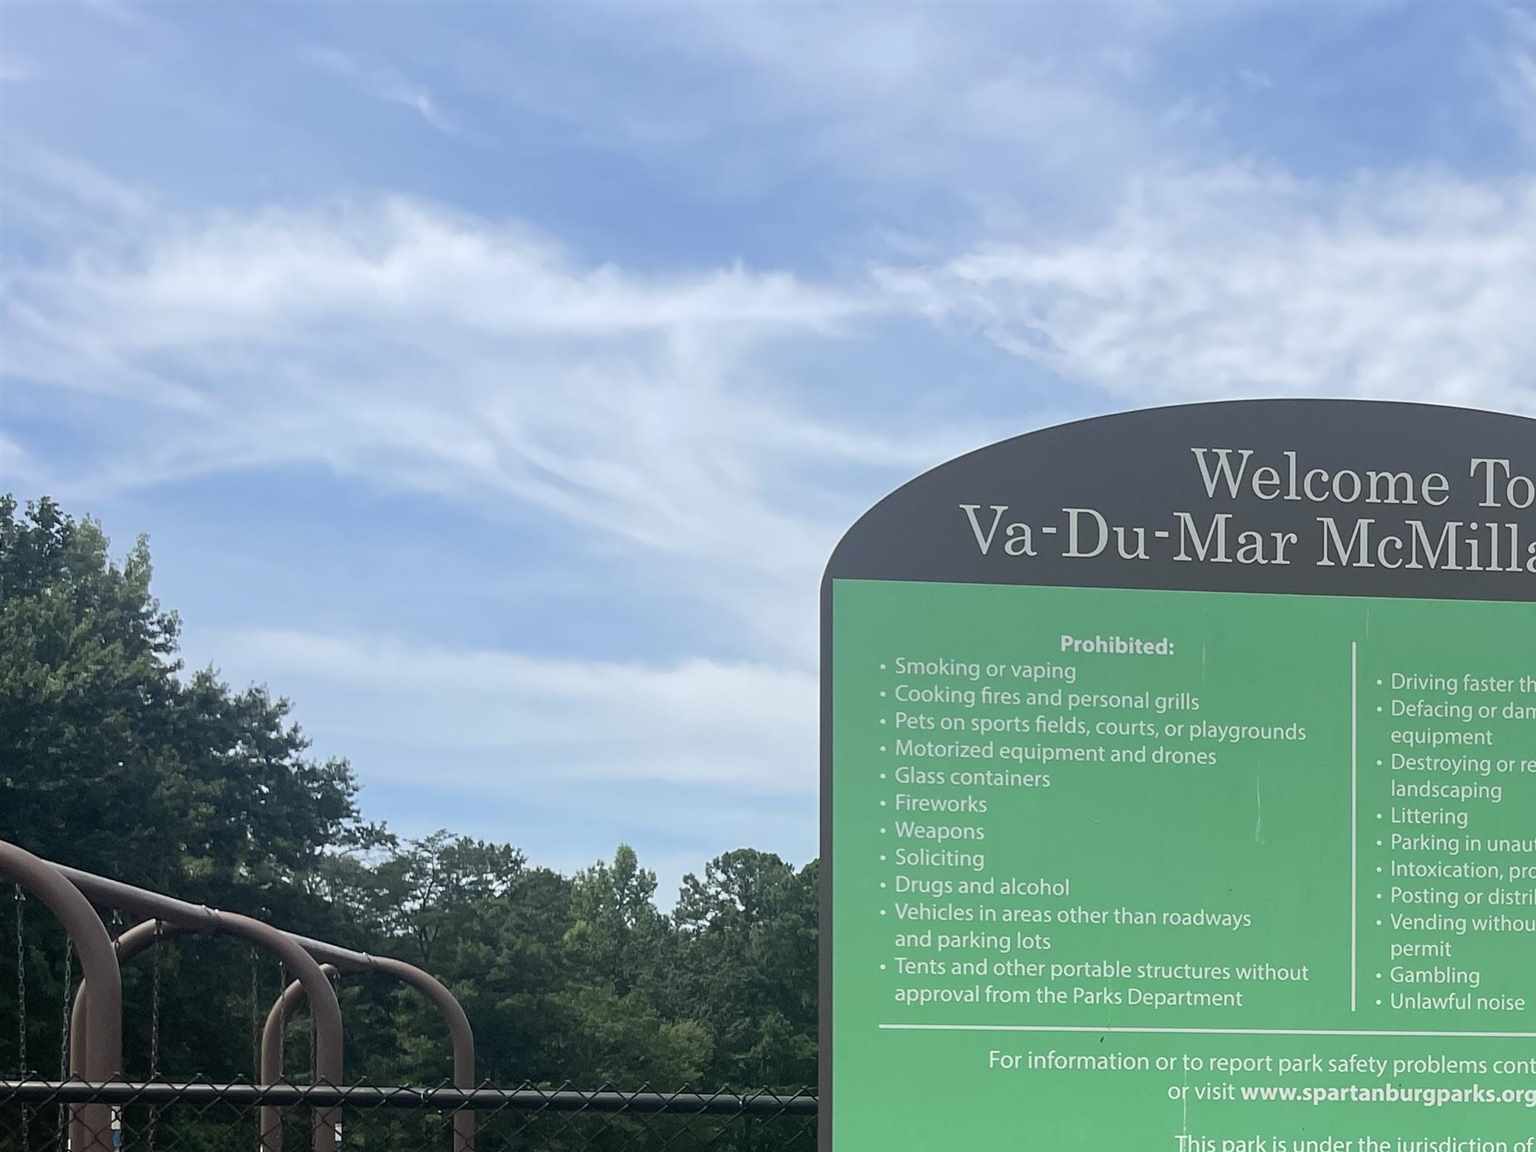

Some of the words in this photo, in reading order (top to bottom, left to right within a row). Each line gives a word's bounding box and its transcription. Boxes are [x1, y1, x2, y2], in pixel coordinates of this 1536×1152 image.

[1190, 447, 1450, 506] Welcome
[1469, 457, 1536, 509] To
[958, 503, 1298, 565] Va-Du-Mar
[1060, 634, 1175, 656] Prohibited:
[895, 656, 981, 682] Smoking
[985, 663, 1007, 678] or
[1008, 661, 1077, 684] vaping
[1391, 672, 1458, 696] Driving
[1463, 673, 1515, 693] faster
[894, 684, 976, 709] Cooking
[980, 685, 1022, 705] fires
[1025, 688, 1062, 707] and
[1067, 691, 1150, 711] personal
[1154, 692, 1200, 714] grills
[1391, 698, 1473, 723] Defacing
[1477, 705, 1498, 719] or
[895, 711, 936, 731] Pets
[939, 716, 966, 731] on
[970, 716, 1031, 736] sports
[1034, 714, 1091, 737] fields,
[1095, 720, 1160, 739] courts,
[1164, 723, 1185, 737] or
[1189, 719, 1307, 744] playgrounds
[1390, 727, 1493, 749] equipment
[895, 738, 994, 759] Motorized
[998, 743, 1106, 765] equipment
[1109, 744, 1147, 763] and
[1151, 745, 1217, 765] drones
[894, 765, 946, 785] Glass
[949, 769, 1051, 788] containers
[1391, 752, 1491, 777] Destroying
[1496, 759, 1516, 773] or
[895, 793, 988, 813] Fireworks
[1391, 778, 1503, 804] landscaping
[1391, 806, 1468, 830] Littering
[894, 820, 985, 844] Weapons
[1391, 832, 1460, 856] Parking
[1465, 834, 1482, 852] in
[895, 847, 985, 872] Soliciting
[1391, 859, 1504, 881] Intoxication,
[895, 874, 953, 898] Drugs
[957, 876, 995, 895] and
[999, 877, 1070, 897] alcohol
[894, 902, 975, 922] Vehicles
[979, 904, 997, 922] in
[1001, 908, 1052, 923] areas
[1056, 905, 1110, 924] other
[1112, 906, 1157, 925] than
[1162, 908, 1252, 931] roadways
[1389, 912, 1467, 936] Vending
[894, 929, 932, 948] and
[937, 930, 1011, 954] parking
[1016, 931, 1052, 950] lots
[1390, 940, 1453, 961] permit
[893, 956, 947, 975] Tents
[950, 957, 988, 976] and
[992, 958, 1046, 977] other
[1050, 959, 1133, 981] portable
[1136, 962, 1231, 980] structures
[1234, 962, 1310, 982] without
[1390, 965, 1481, 989] Gambling
[1390, 991, 1472, 1011] Unlawful
[1476, 993, 1526, 1011] noise
[989, 1049, 1023, 1069] For
[1028, 1049, 1150, 1071] information
[1155, 1056, 1178, 1071] or
[1182, 1054, 1204, 1073] to
[1209, 1055, 1273, 1076] report
[1278, 1053, 1323, 1077] park
[1327, 1053, 1388, 1078] safety
[1393, 1054, 1488, 1078] problems
[1167, 1084, 1190, 1101] or
[1194, 1082, 1236, 1101] visit
